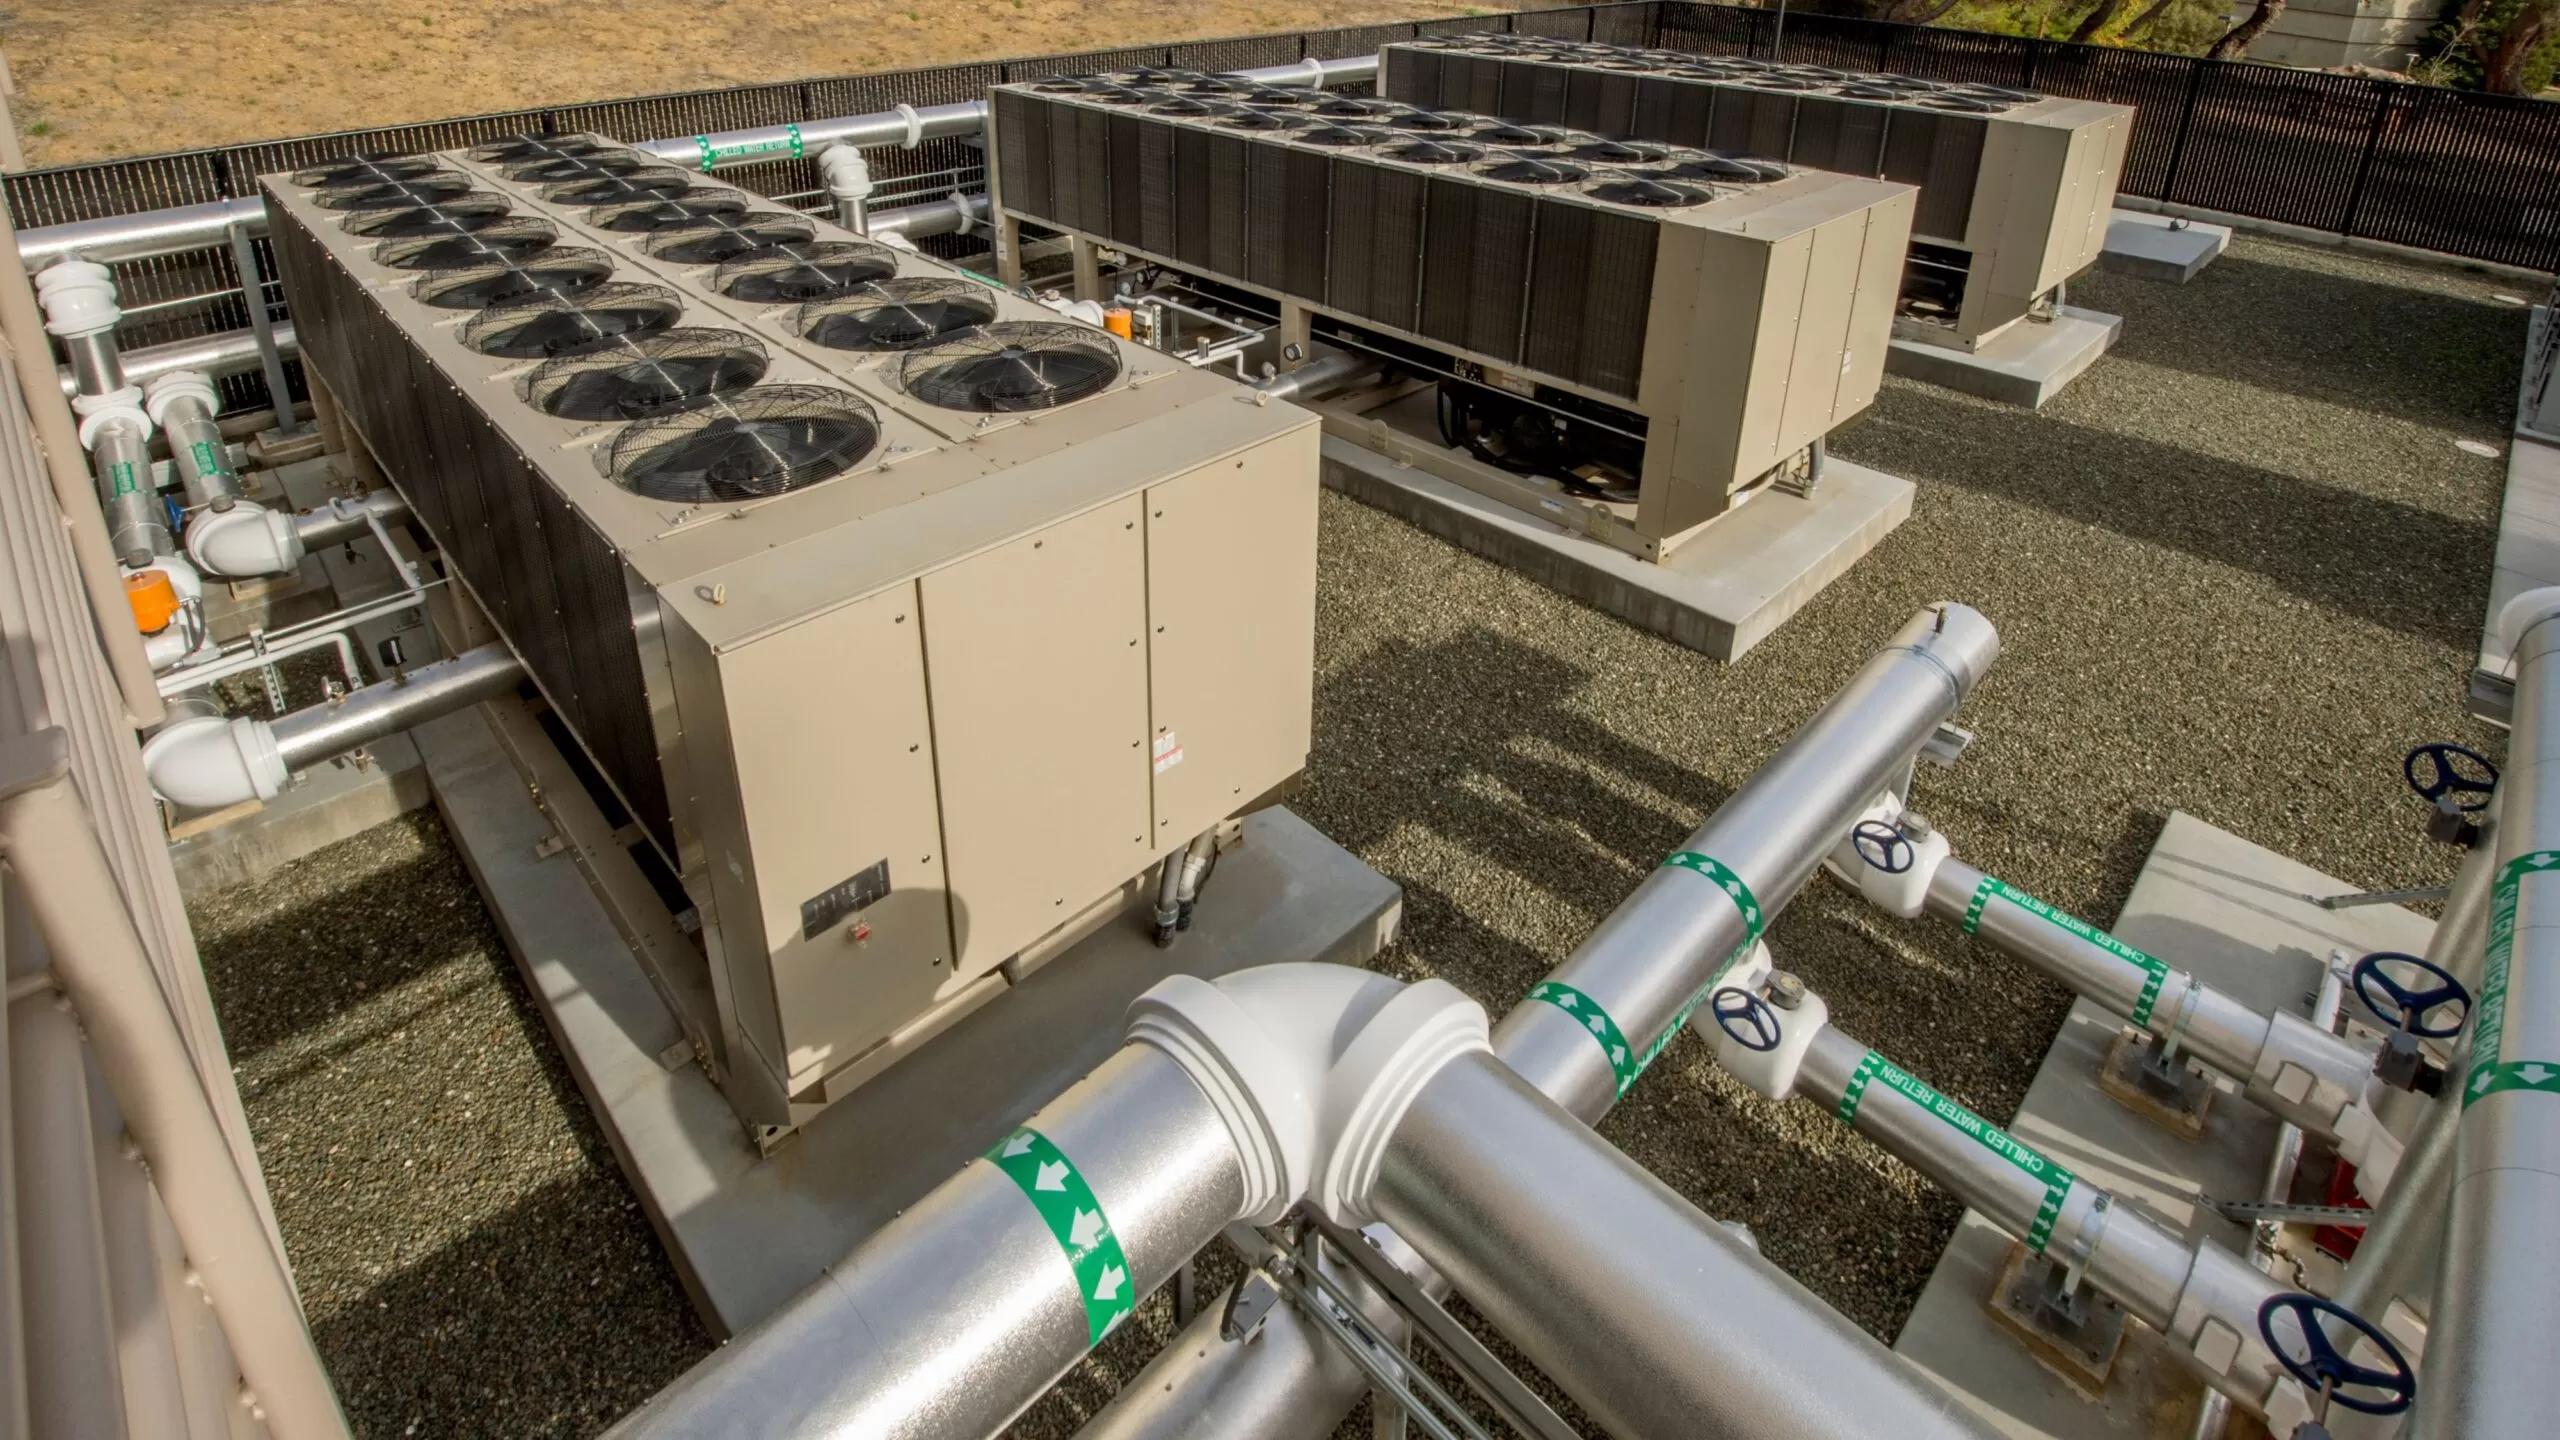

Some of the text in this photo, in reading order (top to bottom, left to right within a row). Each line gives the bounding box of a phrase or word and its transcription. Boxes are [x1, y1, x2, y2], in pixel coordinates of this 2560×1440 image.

[2002, 886, 2146, 963] CHILLED WATER RETURN
[1879, 1064, 2045, 1172] CHILLED WATER RETURN
